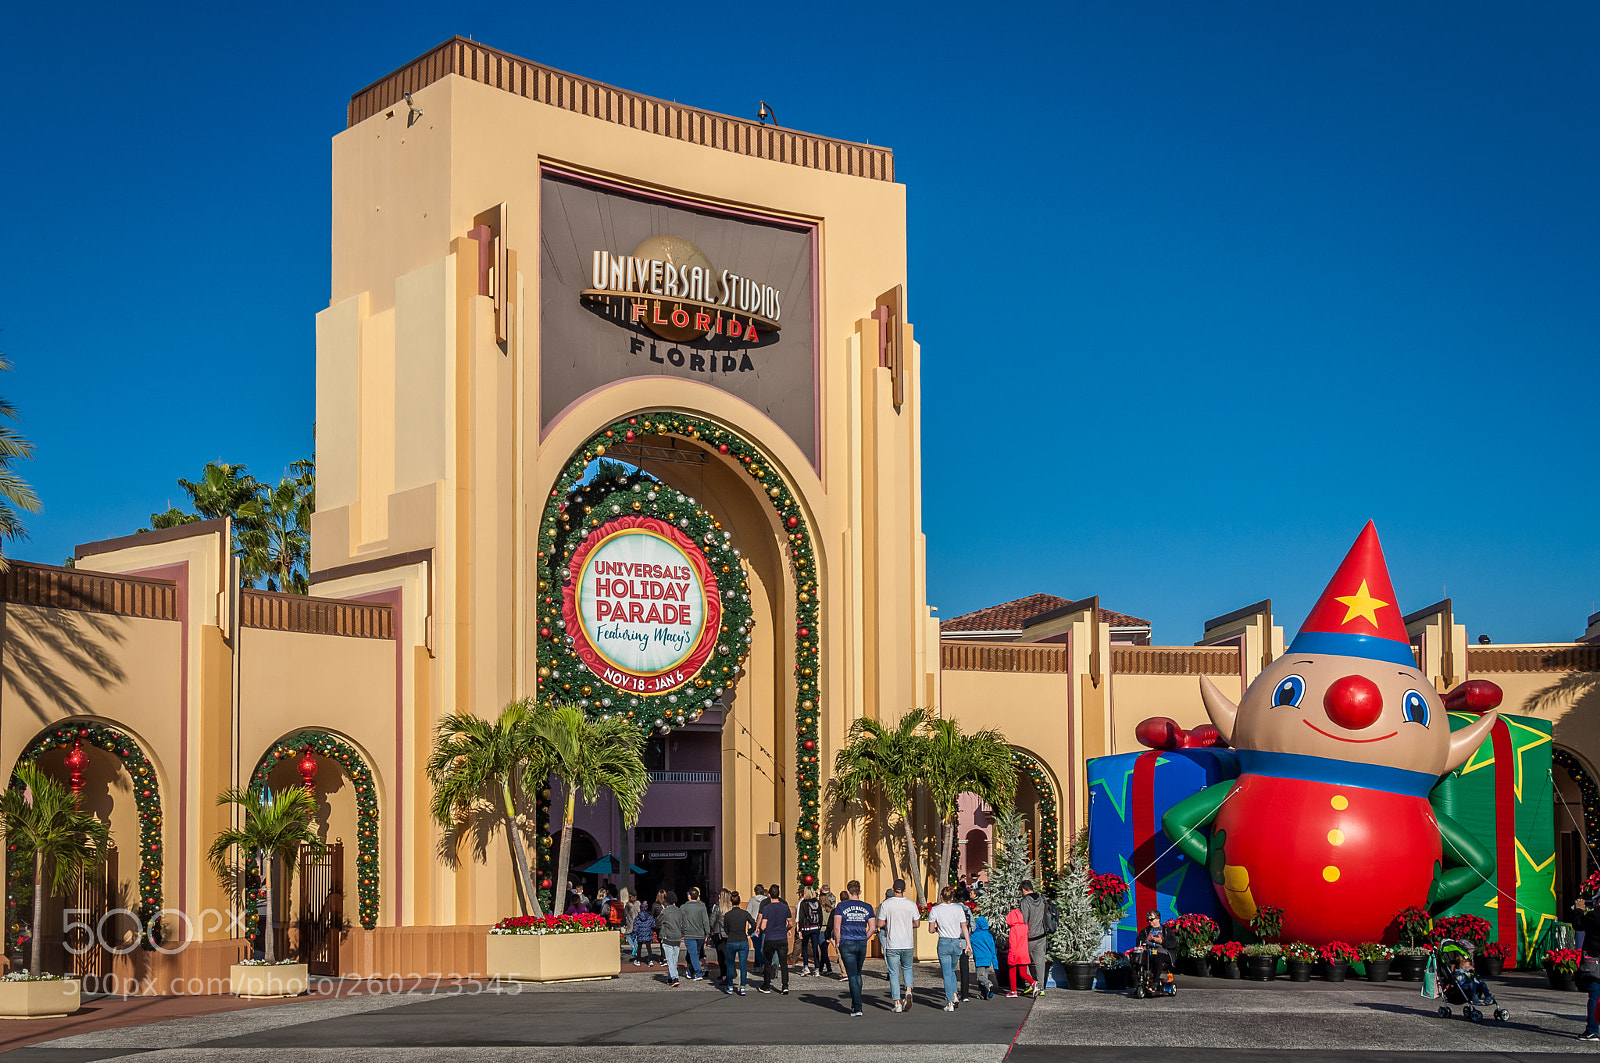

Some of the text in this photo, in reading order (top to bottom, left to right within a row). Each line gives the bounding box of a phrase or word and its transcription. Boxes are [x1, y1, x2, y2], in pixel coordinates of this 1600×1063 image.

[592, 250, 781, 321] UNIVERSAL STUDIOS
[632, 304, 760, 343] FLORIDA
[594, 560, 691, 581] UNIVERSAL'S
[595, 577, 691, 602] HOLIDAY
[596, 600, 692, 626] PARADE
[596, 623, 691, 652] Featuring Macy's
[603, 667, 630, 687] NOV
[633, 678, 645, 691] 18
[655, 674, 676, 691] JAN
[676, 670, 684, 682] 6
